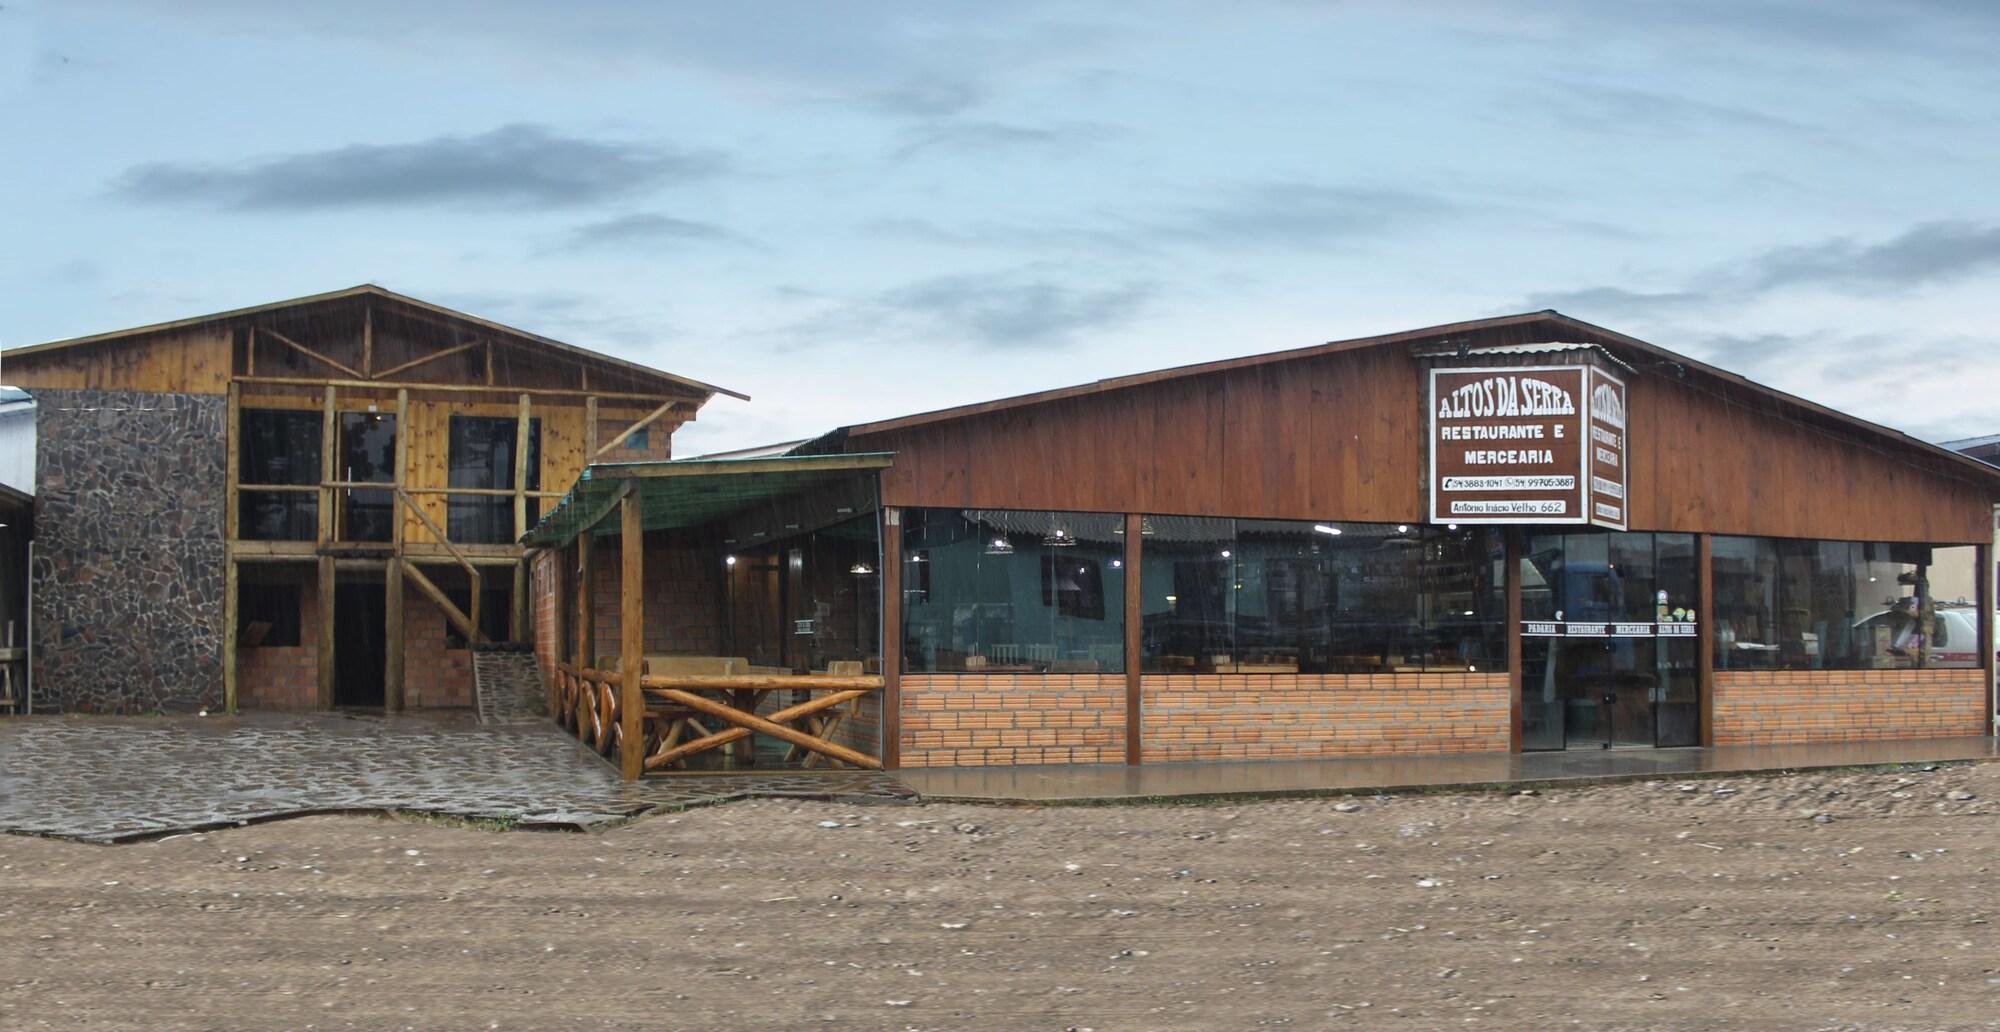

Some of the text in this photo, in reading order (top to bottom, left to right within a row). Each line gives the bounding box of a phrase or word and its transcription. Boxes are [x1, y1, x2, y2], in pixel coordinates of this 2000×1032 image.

[1439, 379, 1494, 418] ALTOS
[1496, 376, 1519, 416] DA
[1521, 378, 1575, 416] SERRA
[1441, 424, 1564, 440] RESTAURANTE E
[1464, 450, 1553, 464] MERCEARIA
[1511, 502, 1536, 512] Velho
[1541, 502, 1562, 512] 662
[1528, 624, 1556, 633] PADARIA
